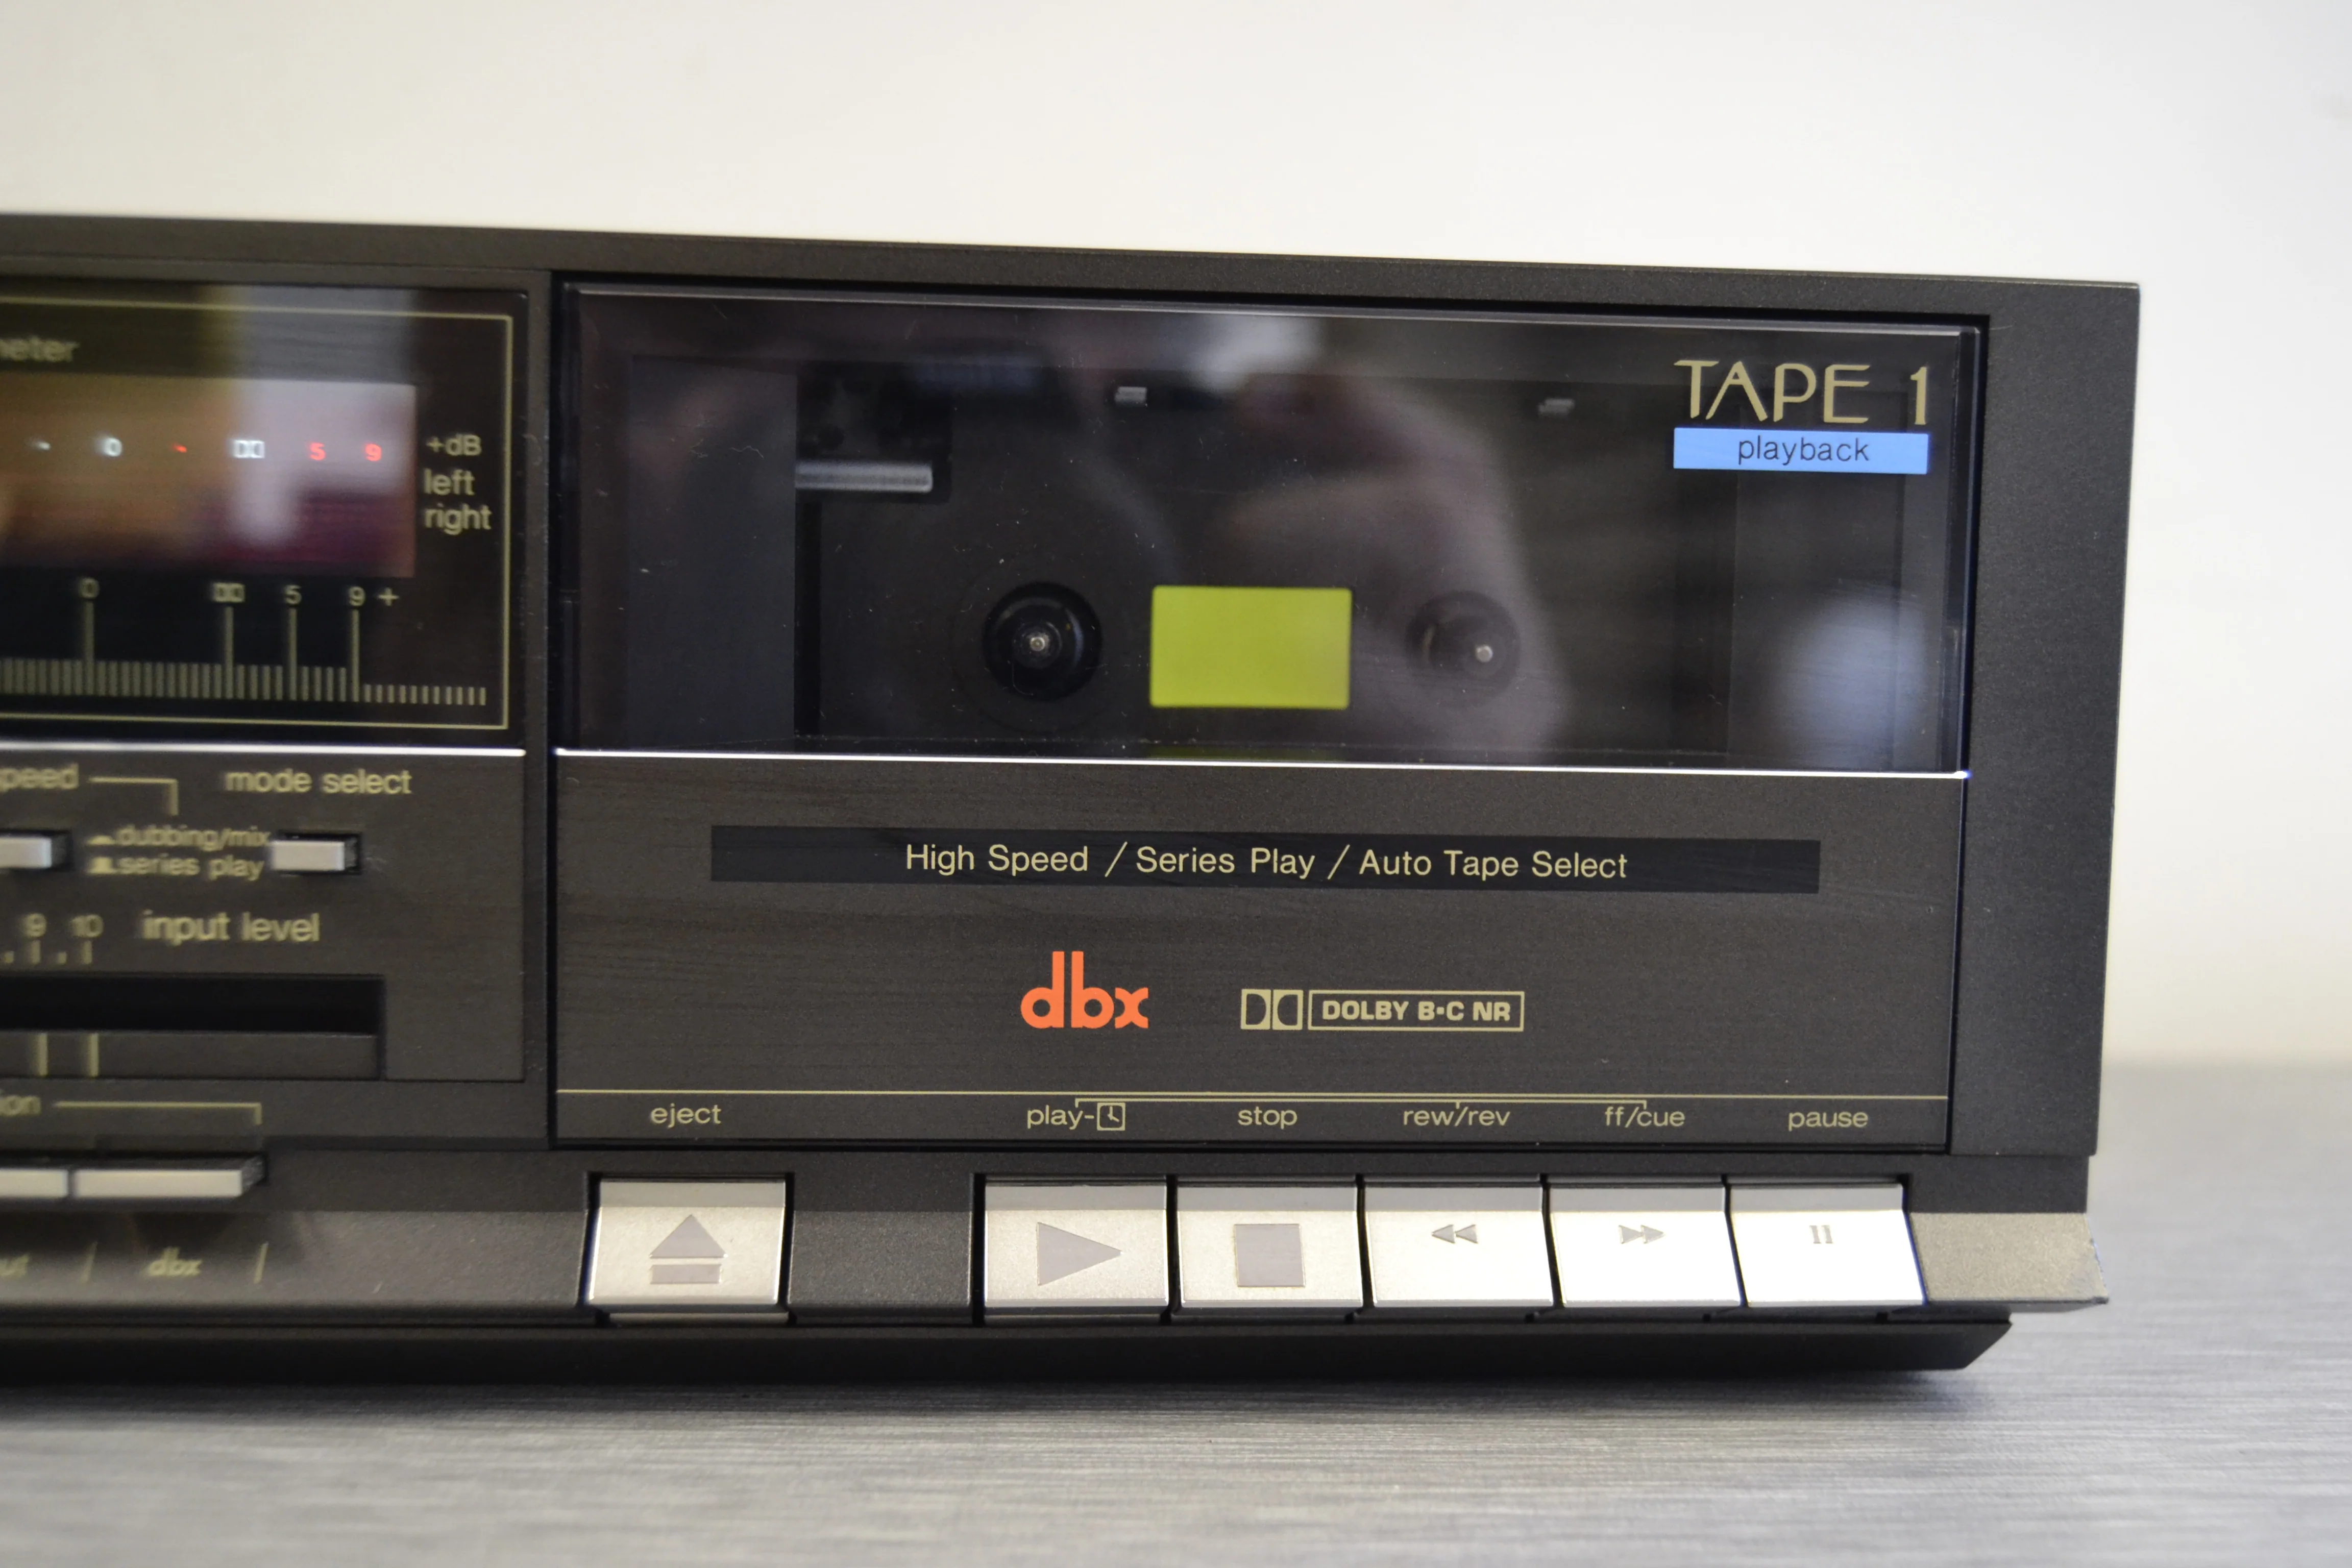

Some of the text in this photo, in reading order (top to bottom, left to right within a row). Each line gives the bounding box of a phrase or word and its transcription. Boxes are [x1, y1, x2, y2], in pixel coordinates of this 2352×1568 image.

[1674, 360, 1927, 425] TAPE 1
[310, 443, 326, 460] 5
[364, 444, 382, 461] 9
[427, 434, 481, 456] +dB
[1738, 435, 1869, 465] playback
[424, 469, 474, 495] left
[425, 503, 491, 535] right
[285, 585, 301, 604] 5
[349, 586, 364, 606] 9
[226, 769, 411, 794] mode select
[120, 855, 264, 880] series play
[907, 844, 974, 875] High
[989, 844, 1088, 876] Speed
[1137, 846, 1235, 873] Series
[1252, 848, 1315, 879] Play
[1359, 849, 1431, 875] Auto
[1444, 850, 1518, 880] Tape
[1532, 851, 1627, 878] Select
[24, 914, 102, 938] 9 10
[143, 911, 319, 945] input level
[1021, 951, 1148, 1028] dbx
[1322, 1000, 1409, 1020] DOLBY
[1473, 1001, 1510, 1021] NR
[649, 1102, 721, 1128] eject
[1238, 1107, 1297, 1129] stop
[1404, 1106, 1510, 1126] rew/rev
[1605, 1104, 1685, 1128] ff/cue
[1788, 1112, 1868, 1131] pause
